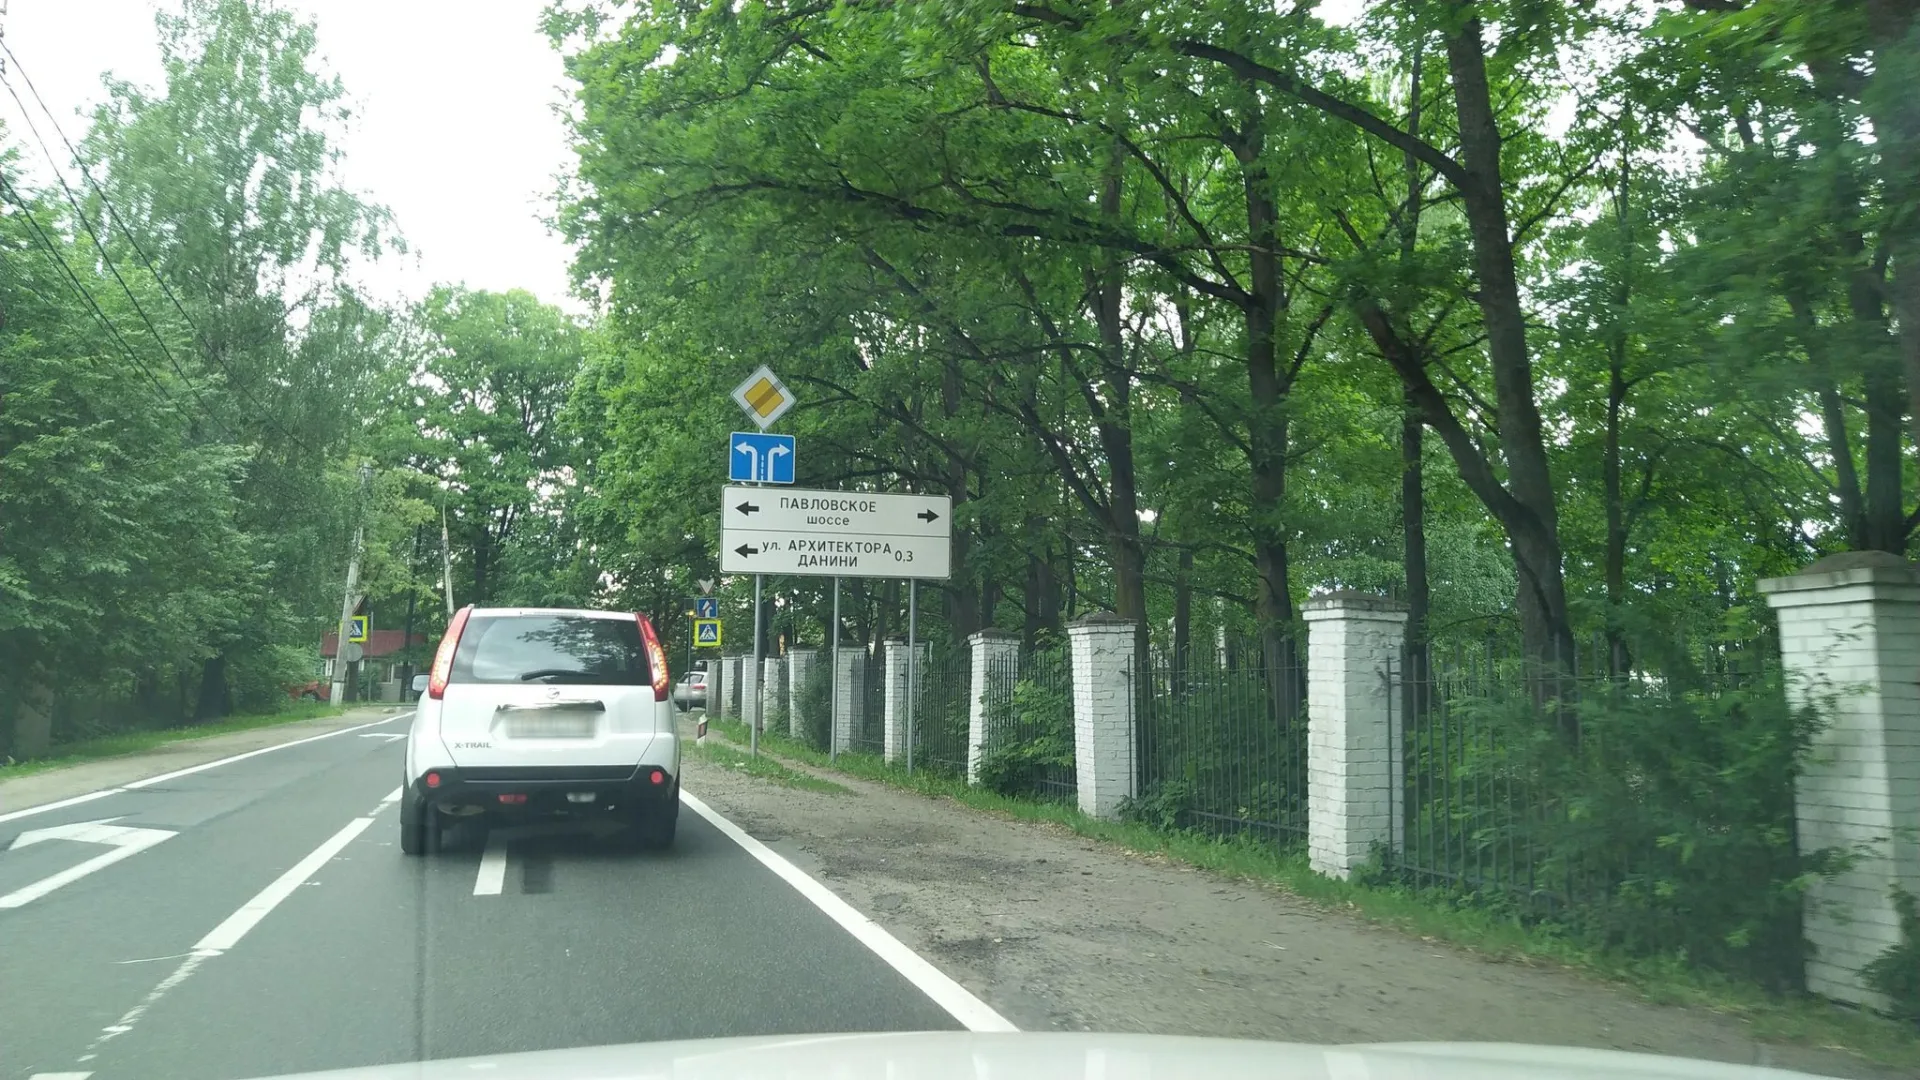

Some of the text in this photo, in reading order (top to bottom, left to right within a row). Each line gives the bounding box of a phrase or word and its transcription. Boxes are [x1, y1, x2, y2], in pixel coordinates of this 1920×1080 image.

[780, 497, 876, 512] ПАВЛОВСКОЕ
[807, 515, 850, 526] шоссе
[762, 539, 892, 554] ул. АРХИТЕКТОРА
[797, 554, 858, 568] ДАНИНИ
